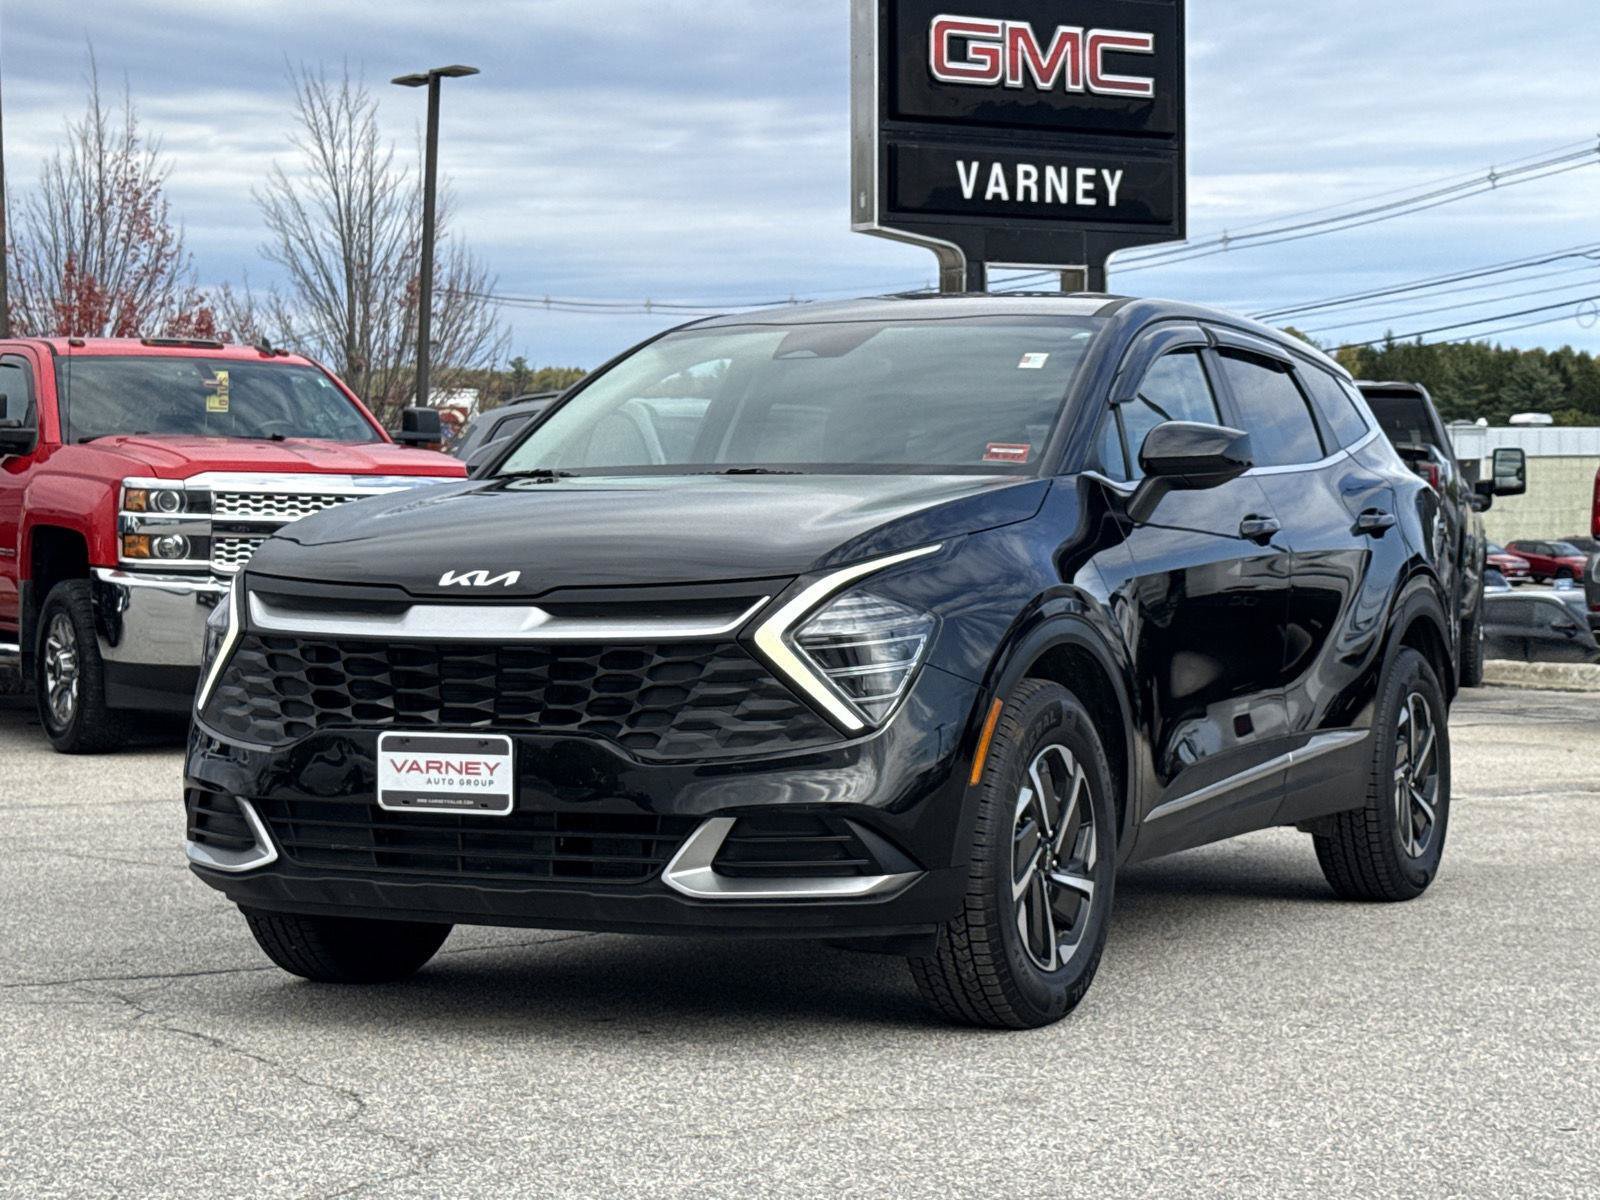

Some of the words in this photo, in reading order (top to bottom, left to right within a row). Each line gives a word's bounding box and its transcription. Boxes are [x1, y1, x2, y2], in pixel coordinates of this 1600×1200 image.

[930, 14, 1155, 97] GMC
[956, 160, 1123, 206] VARNEY
[390, 759, 501, 776] VARNEY
[426, 778, 455, 786] AUTO
[459, 779, 494, 787] GROUP
